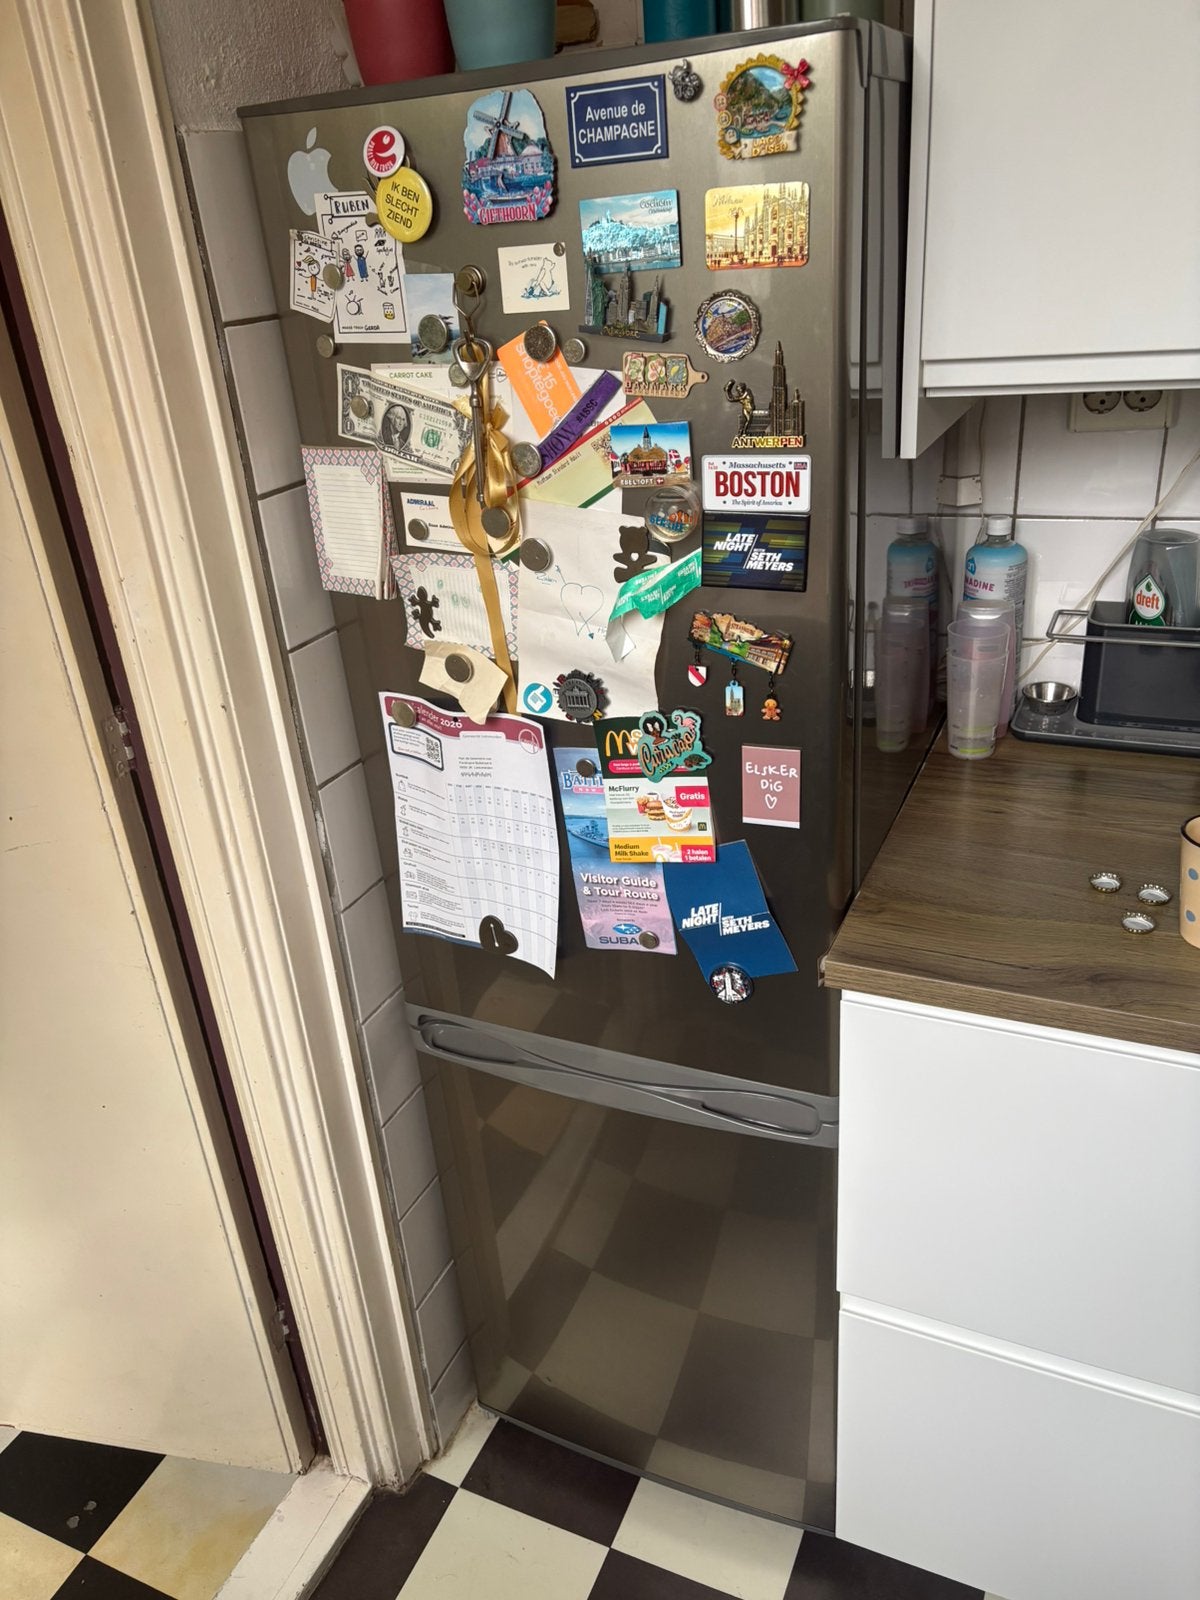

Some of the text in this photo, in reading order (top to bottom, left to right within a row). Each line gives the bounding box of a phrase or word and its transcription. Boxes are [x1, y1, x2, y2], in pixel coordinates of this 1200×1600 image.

[586, 100, 646, 122] Avenue de
[578, 120, 656, 144] CHAMPAGNE
[391, 181, 420, 204] IK BEN
[334, 200, 370, 214] RUBEN
[385, 194, 419, 218] SLECHT
[480, 203, 537, 224] GIETHOORN
[386, 208, 413, 229] ZIEND
[543, 372, 558, 390] 15
[732, 436, 804, 448] ANTWERPEN
[715, 471, 800, 497] BOSTON
[406, 498, 435, 506] ADMIRAAL
[725, 533, 755, 543] LATE
[713, 541, 752, 552] NIGHT
[750, 552, 782, 562] SETH
[746, 560, 794, 571] MEYERS
[1136, 590, 1159, 610] dreft
[440, 717, 463, 729] 2026
[745, 762, 798, 778] ELSKER
[580, 873, 657, 888] Visitor Guide
[583, 886, 659, 900] & Tour Route
[691, 902, 719, 917] LATE
[682, 914, 718, 929] NIGHT
[722, 916, 752, 928] SETH
[722, 920, 770, 936] MEYERS
[599, 936, 640, 945] SUBA
